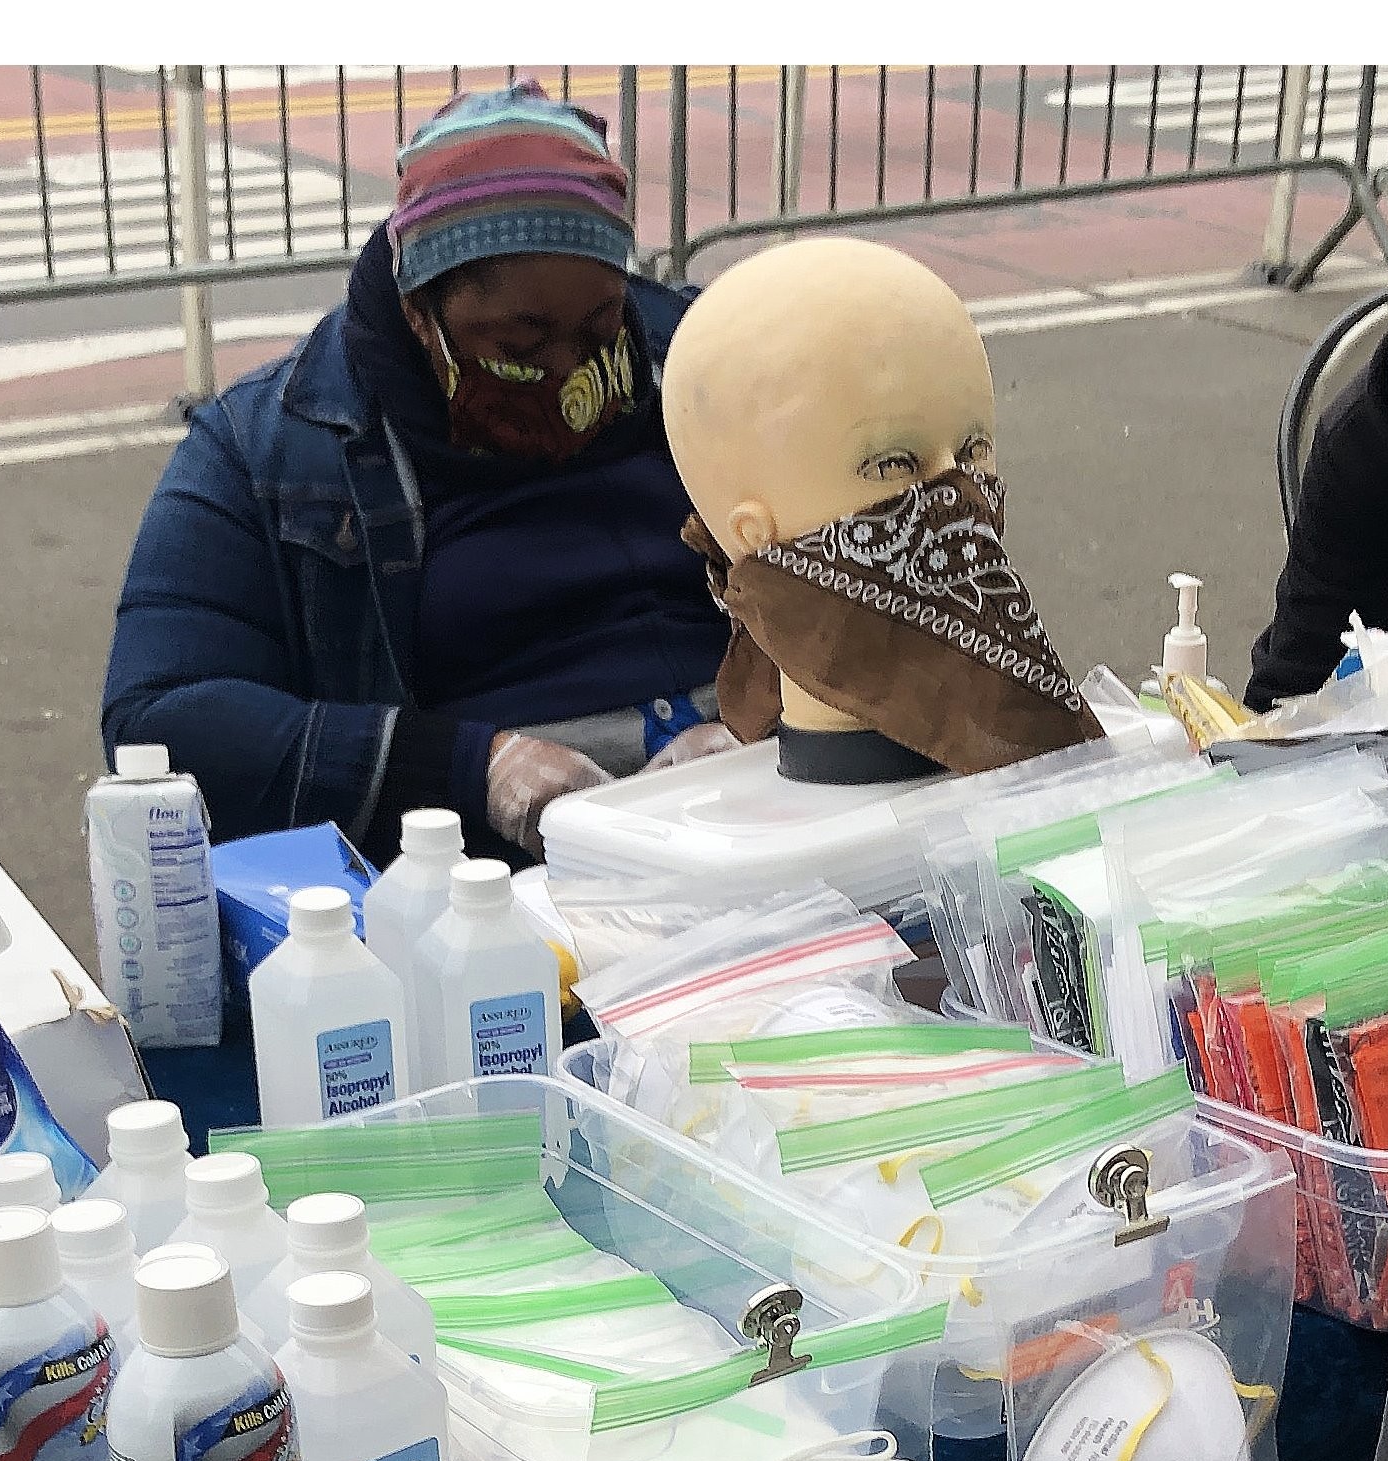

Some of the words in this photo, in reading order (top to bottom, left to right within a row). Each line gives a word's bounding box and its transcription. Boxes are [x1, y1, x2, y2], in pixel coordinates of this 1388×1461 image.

[478, 1042, 543, 1068] Isopropyl
[326, 1069, 391, 1098] Isopropyl
[329, 1092, 380, 1116] Alcohol
[44, 1360, 77, 1382] Kills
[233, 1411, 264, 1433] Kills
